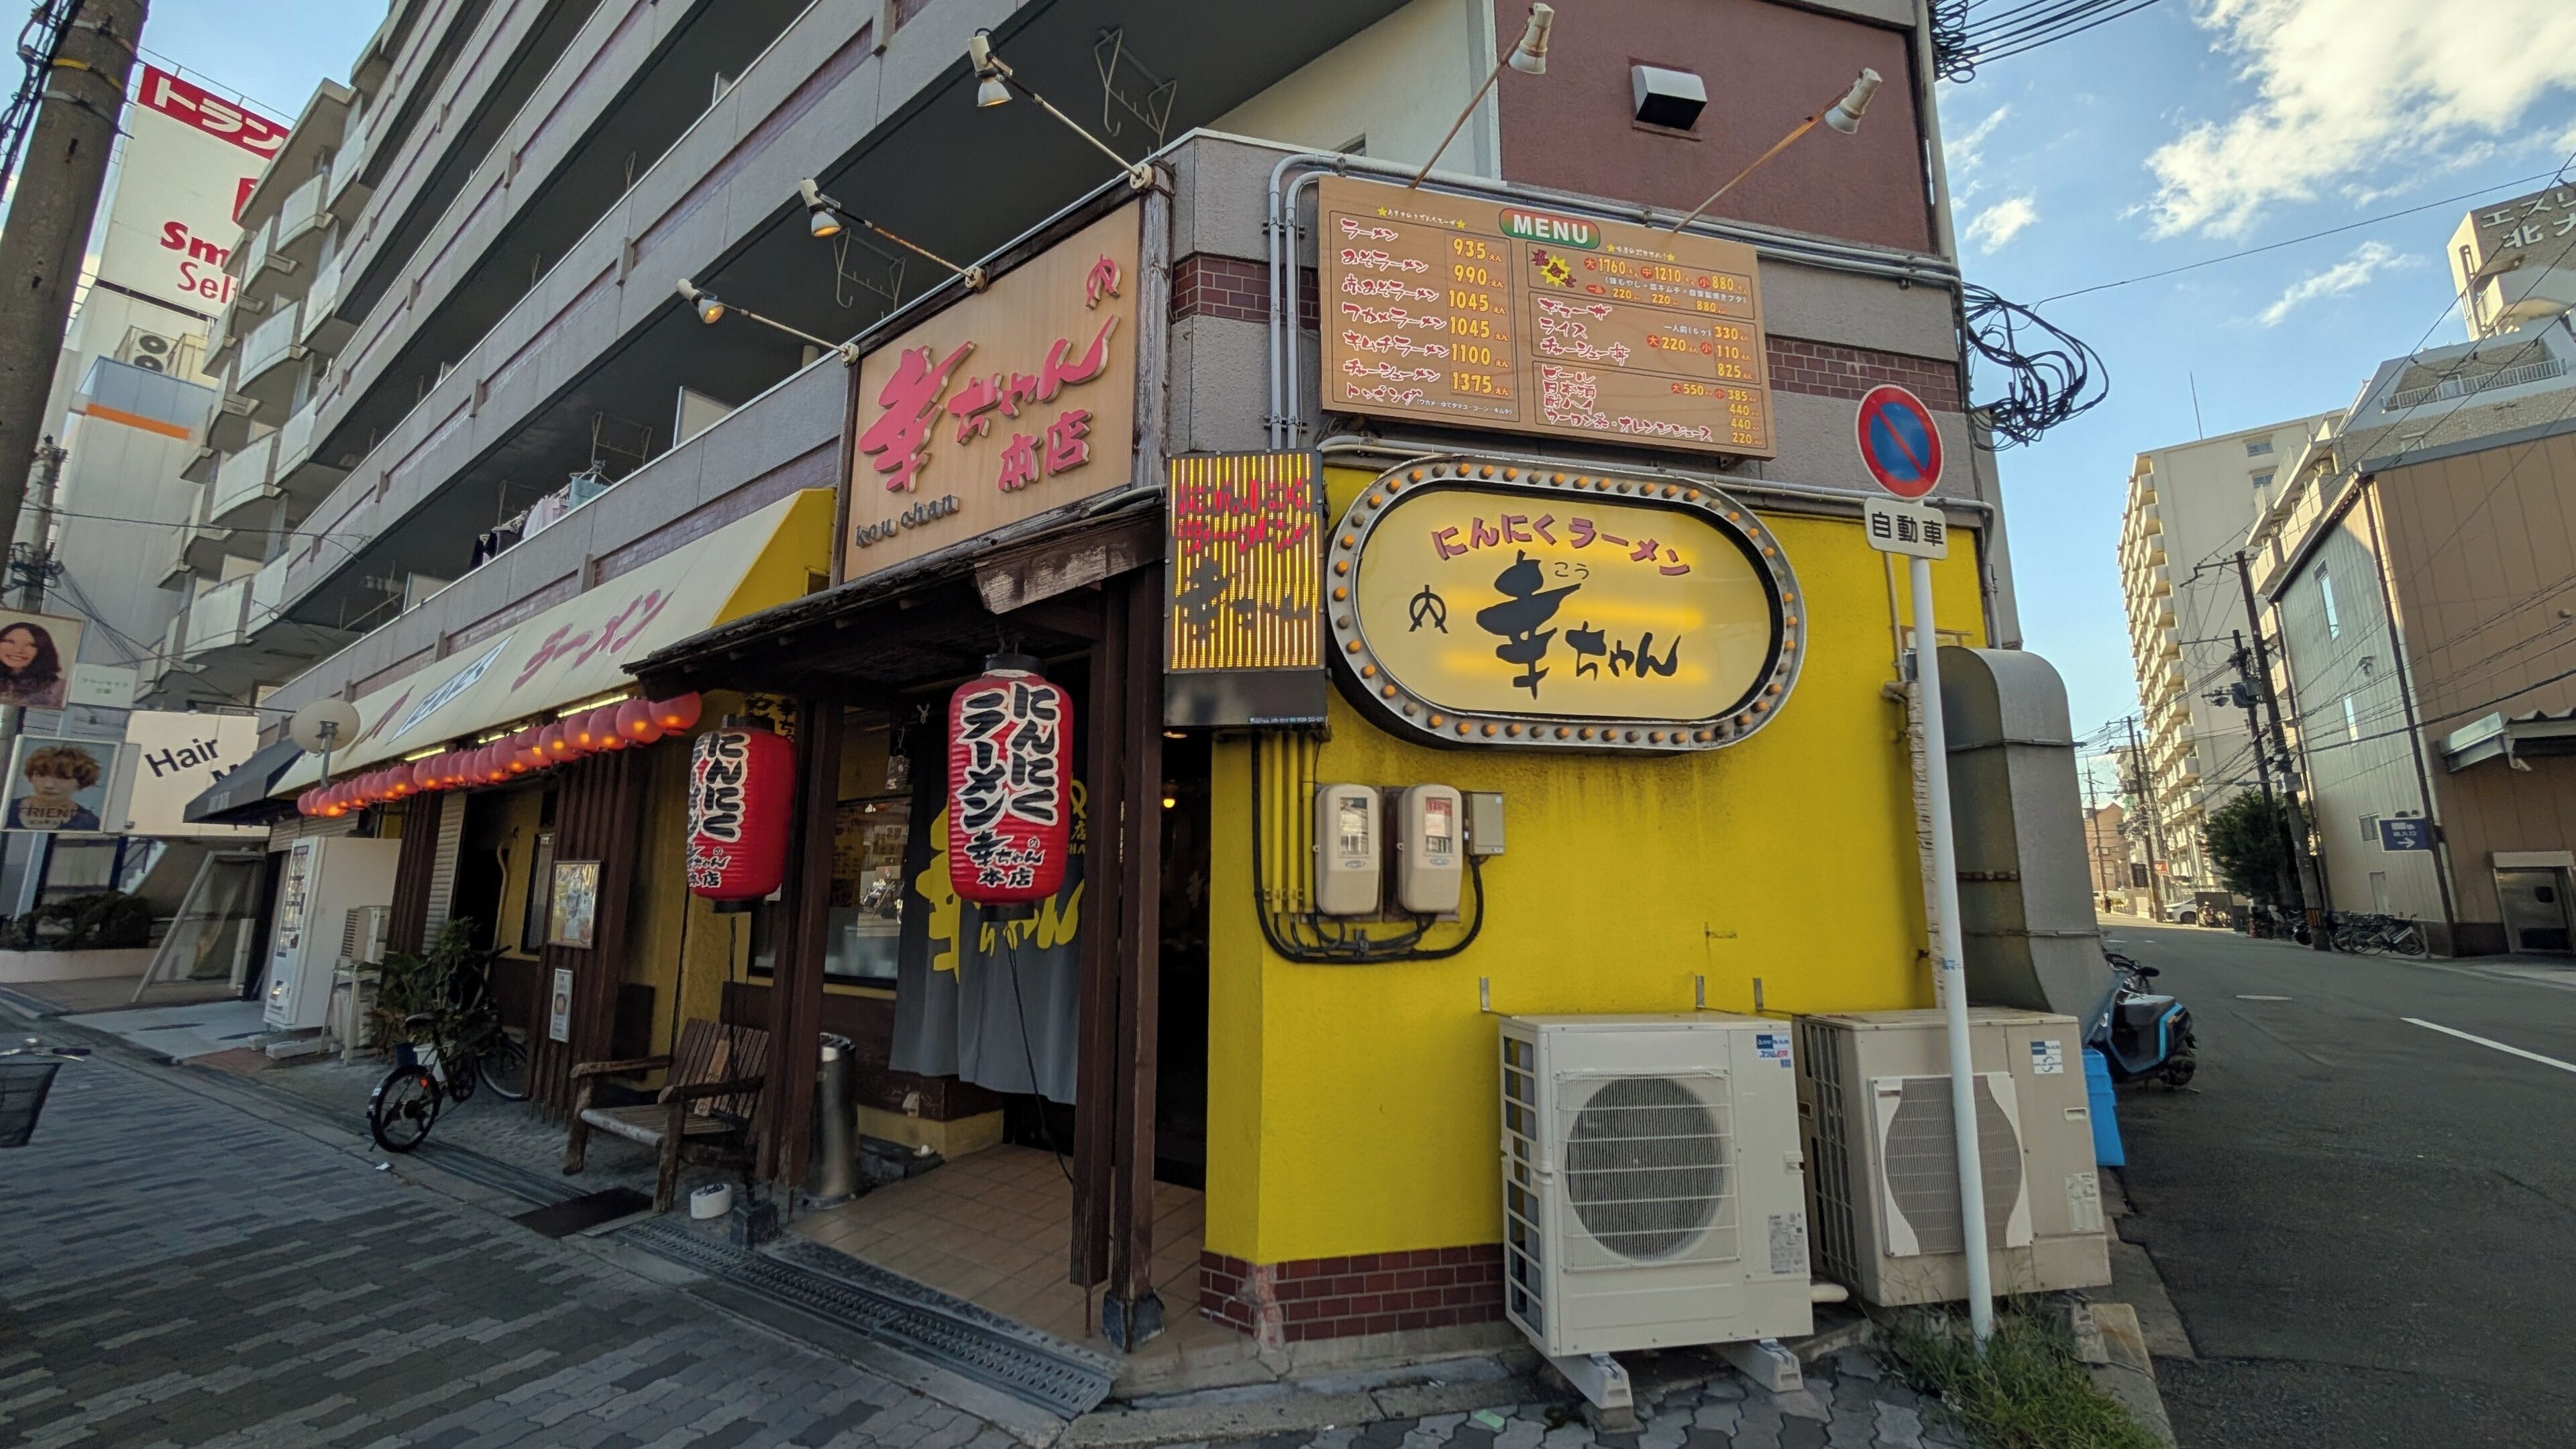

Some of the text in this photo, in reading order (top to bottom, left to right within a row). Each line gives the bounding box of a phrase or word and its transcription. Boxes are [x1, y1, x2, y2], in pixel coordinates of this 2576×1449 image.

[1341, 219, 1398, 241] ラーメン
[1513, 214, 1589, 244] MENU
[1341, 249, 1428, 274] みそラーメン
[1342, 274, 1439, 302] 赤みそラーメン
[1342, 303, 1446, 329] ワカメラーメン
[1538, 298, 1612, 321] ギョーザ
[1539, 317, 1588, 339] ライス
[1343, 331, 1449, 358] キムチラーメン
[1540, 336, 1631, 366] チャーシュー丼
[1344, 358, 1440, 382] チャーシューメン
[1542, 365, 1596, 382] ビール
[859, 314, 1120, 492] 幸ちゃん
[1346, 382, 1423, 405] トッピング
[1543, 381, 1596, 399] 日本酒
[998, 409, 1093, 492] 本店
[855, 492, 959, 547] kou chan
[1872, 511, 1943, 547] 自動車
[1431, 513, 1690, 576] にんにくラーメン
[1554, 561, 1590, 580] こう
[1476, 549, 1681, 700] 幸ちゃん
[511, 590, 675, 694] ラーメン
[145, 739, 219, 777] Hair
[958, 690, 1008, 830] ラーメン
[1010, 682, 1060, 825] にんにく
[702, 733, 751, 842] にんにく
[966, 832, 1044, 867] 幸ちゃん
[978, 868, 1034, 888] 本店
